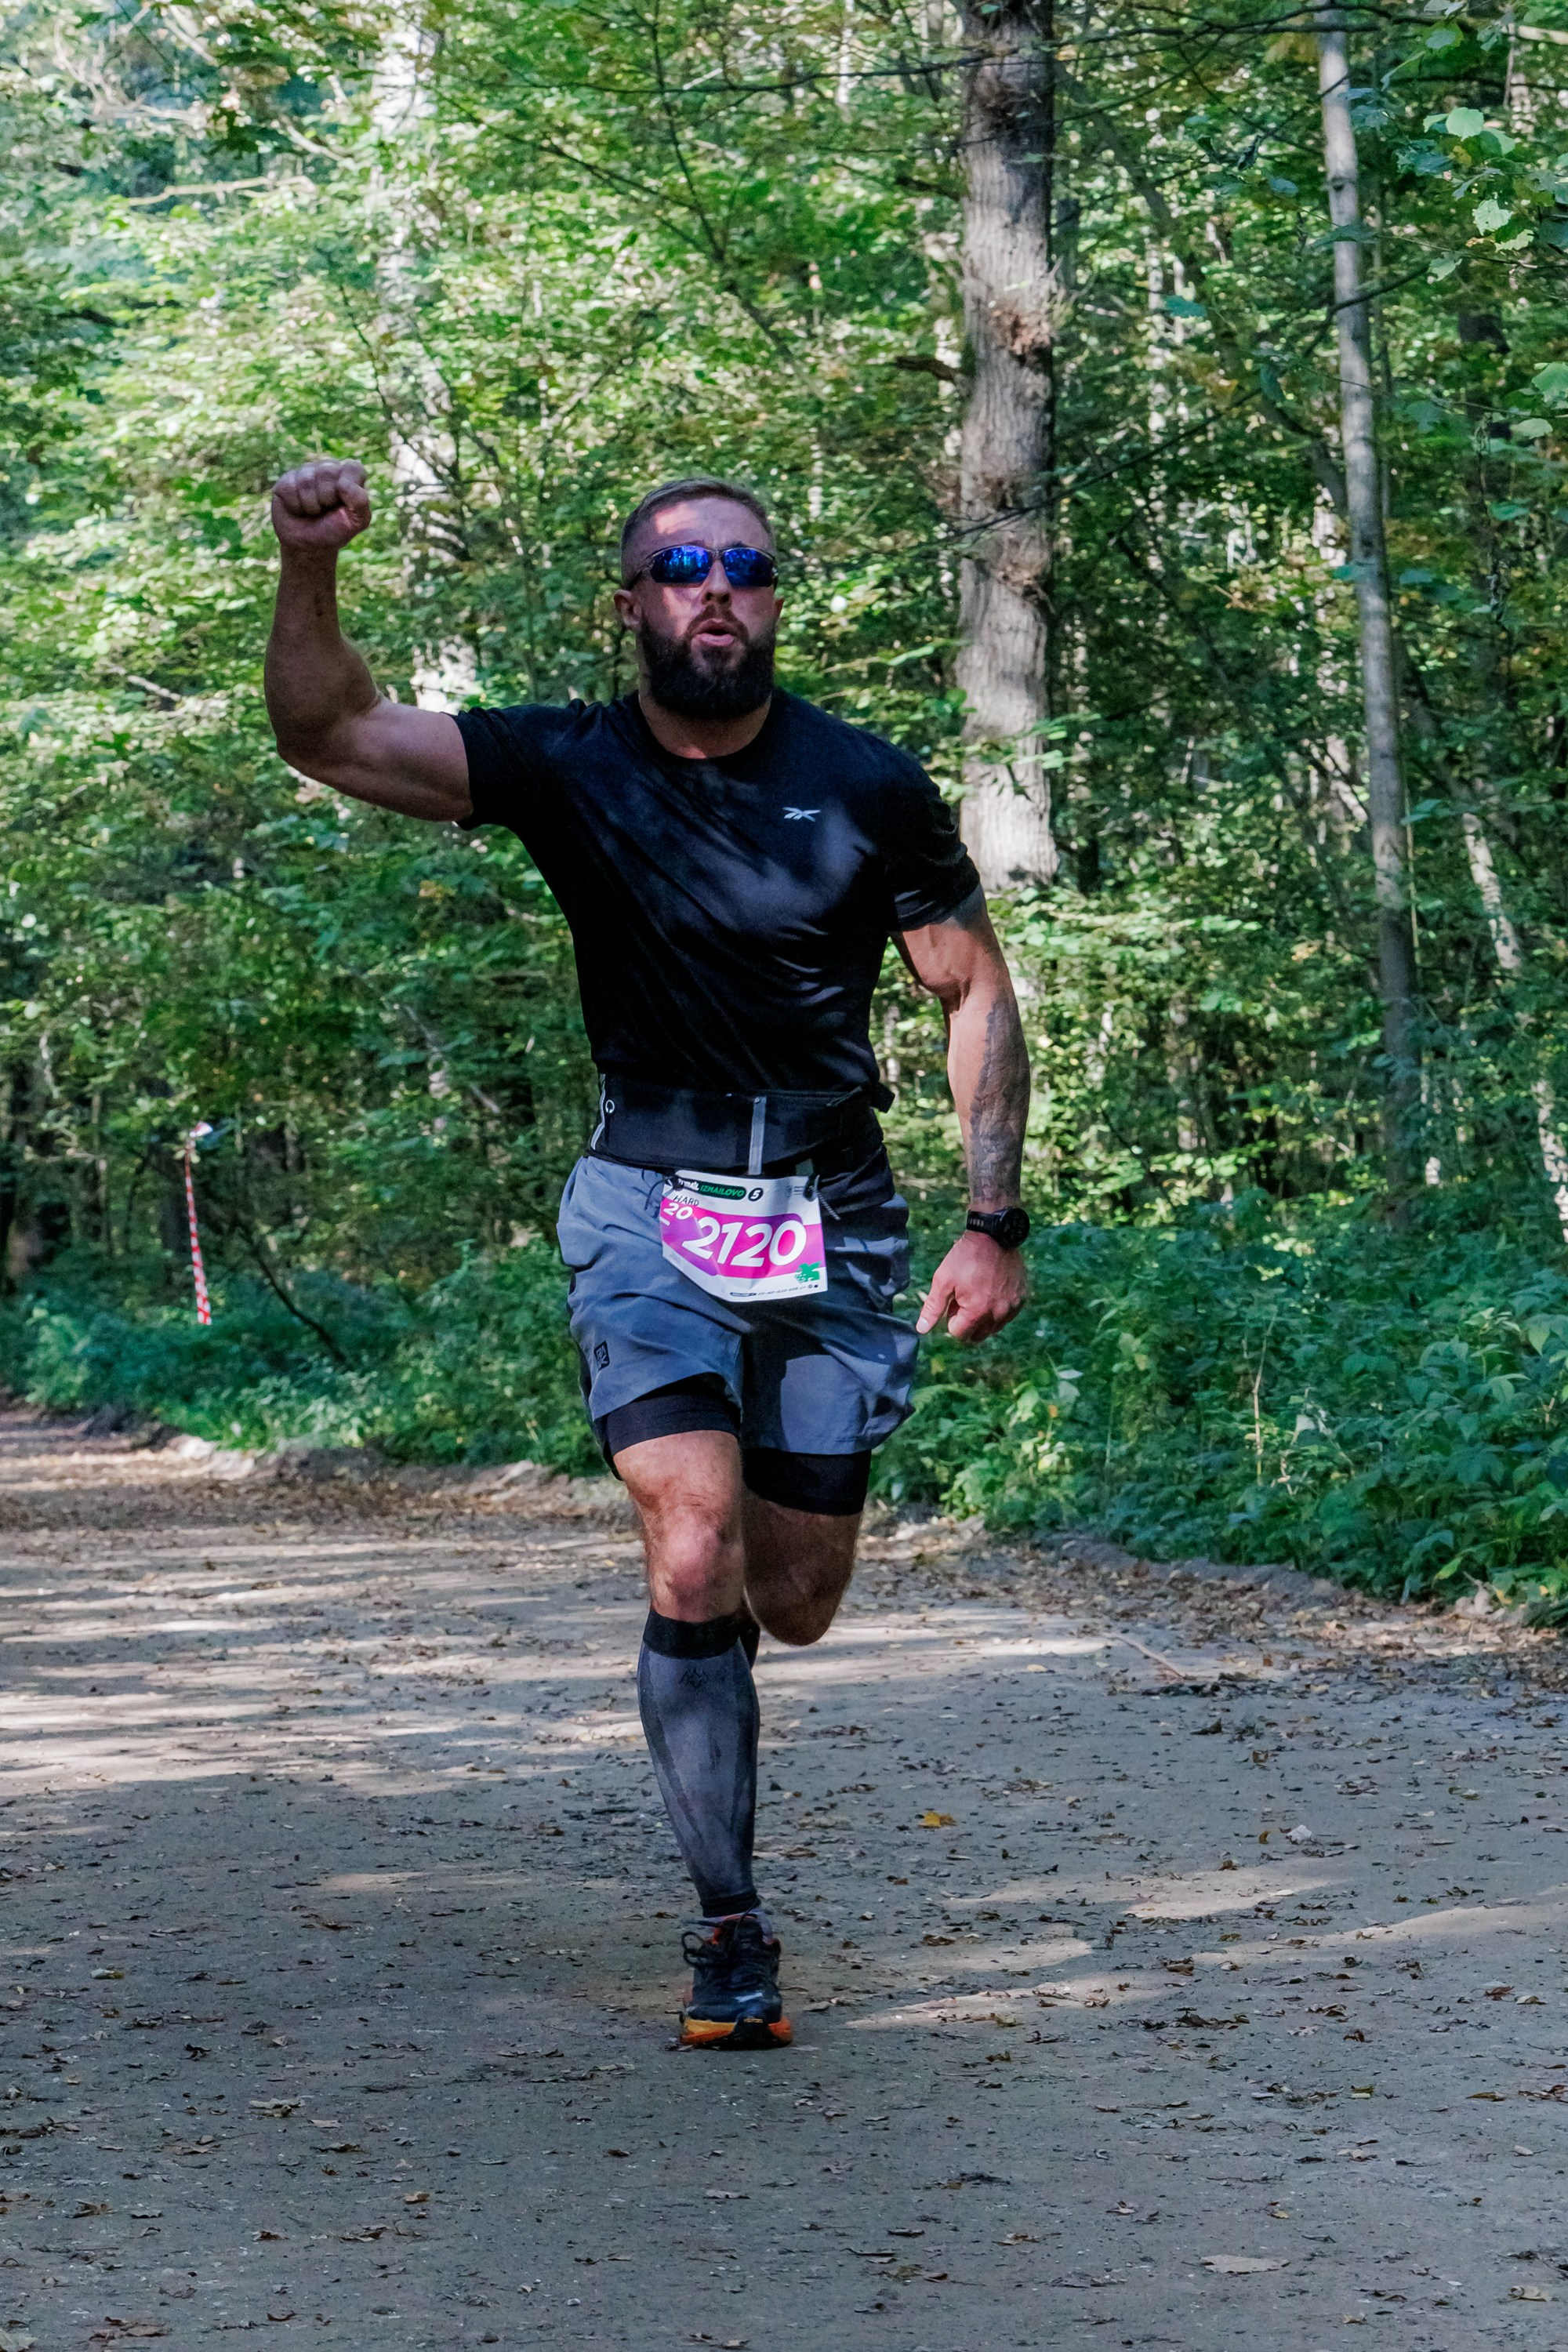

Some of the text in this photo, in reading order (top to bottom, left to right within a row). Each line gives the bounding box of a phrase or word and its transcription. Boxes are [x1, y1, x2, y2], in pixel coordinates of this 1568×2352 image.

[700, 1185, 745, 1197] IZMAILOVO
[673, 1195, 699, 1207] HARD
[663, 1202, 693, 1220] 20
[681, 1216, 807, 1267] 2120
